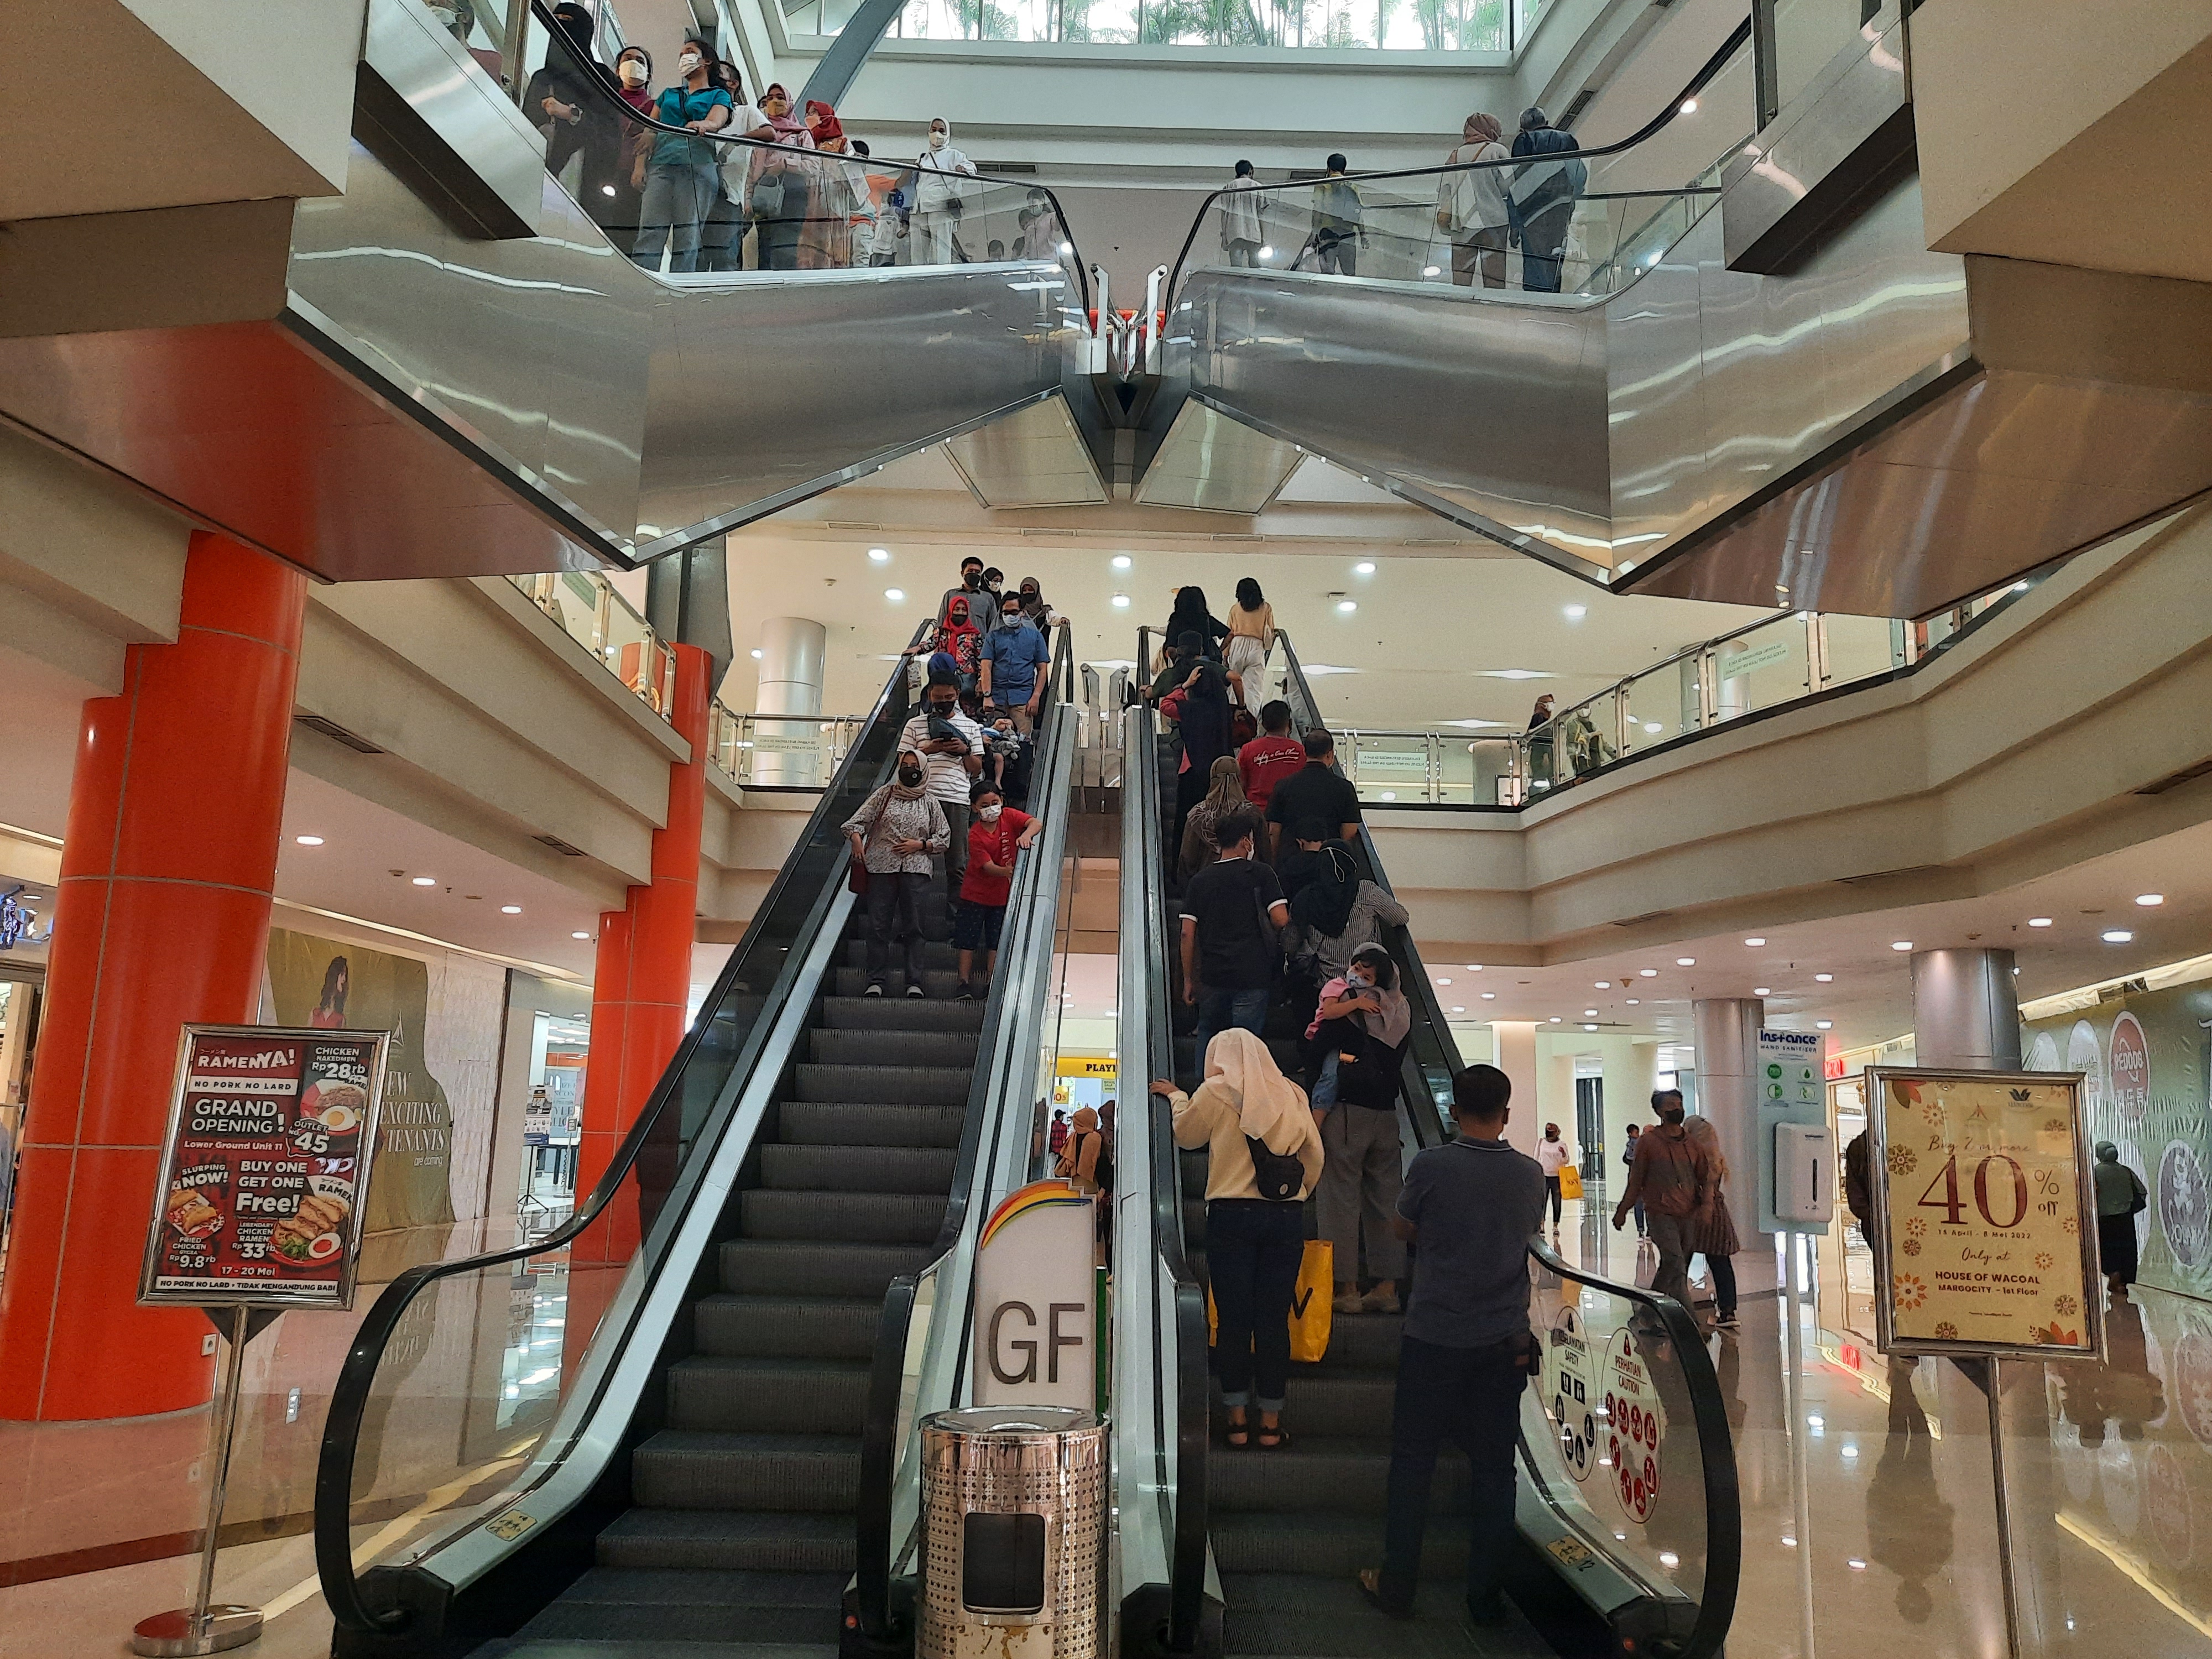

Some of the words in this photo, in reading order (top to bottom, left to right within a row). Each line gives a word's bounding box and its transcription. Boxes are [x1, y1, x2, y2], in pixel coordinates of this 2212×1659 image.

[315, 1047, 360, 1056] CHICKEN
[343, 1078, 367, 1089] RAME
[387, 1071, 412, 1096] EW
[195, 1098, 278, 1117] GRAND
[379, 1100, 442, 1124] EXCITING
[191, 1118, 273, 1133] OPENING
[294, 1120, 329, 1132] OUTLET
[215, 1141, 251, 1149] Ground
[294, 1131, 330, 1153] 45
[387, 1129, 445, 1152] TENANTS
[181, 1164, 226, 1175] SLURPING
[241, 1161, 272, 1172] BUY
[275, 1161, 307, 1173] ONE
[182, 1172, 229, 1189] NOW!
[238, 1176, 269, 1187] GET
[271, 1177, 304, 1188] ONE
[2034, 1170, 2059, 1195] %
[1917, 1155, 2027, 1228] 40
[236, 1192, 301, 1213] Free!
[2038, 1201, 2059, 1216] off
[1962, 1247, 1992, 1265] Only
[1996, 1251, 2011, 1260] at
[241, 1267, 254, 1275] 20
[1936, 1271, 1971, 1281] HOUSE
[1974, 1273, 1988, 1281] OF
[1992, 1274, 2040, 1284] WACOAL
[989, 1301, 1085, 1384] GF
